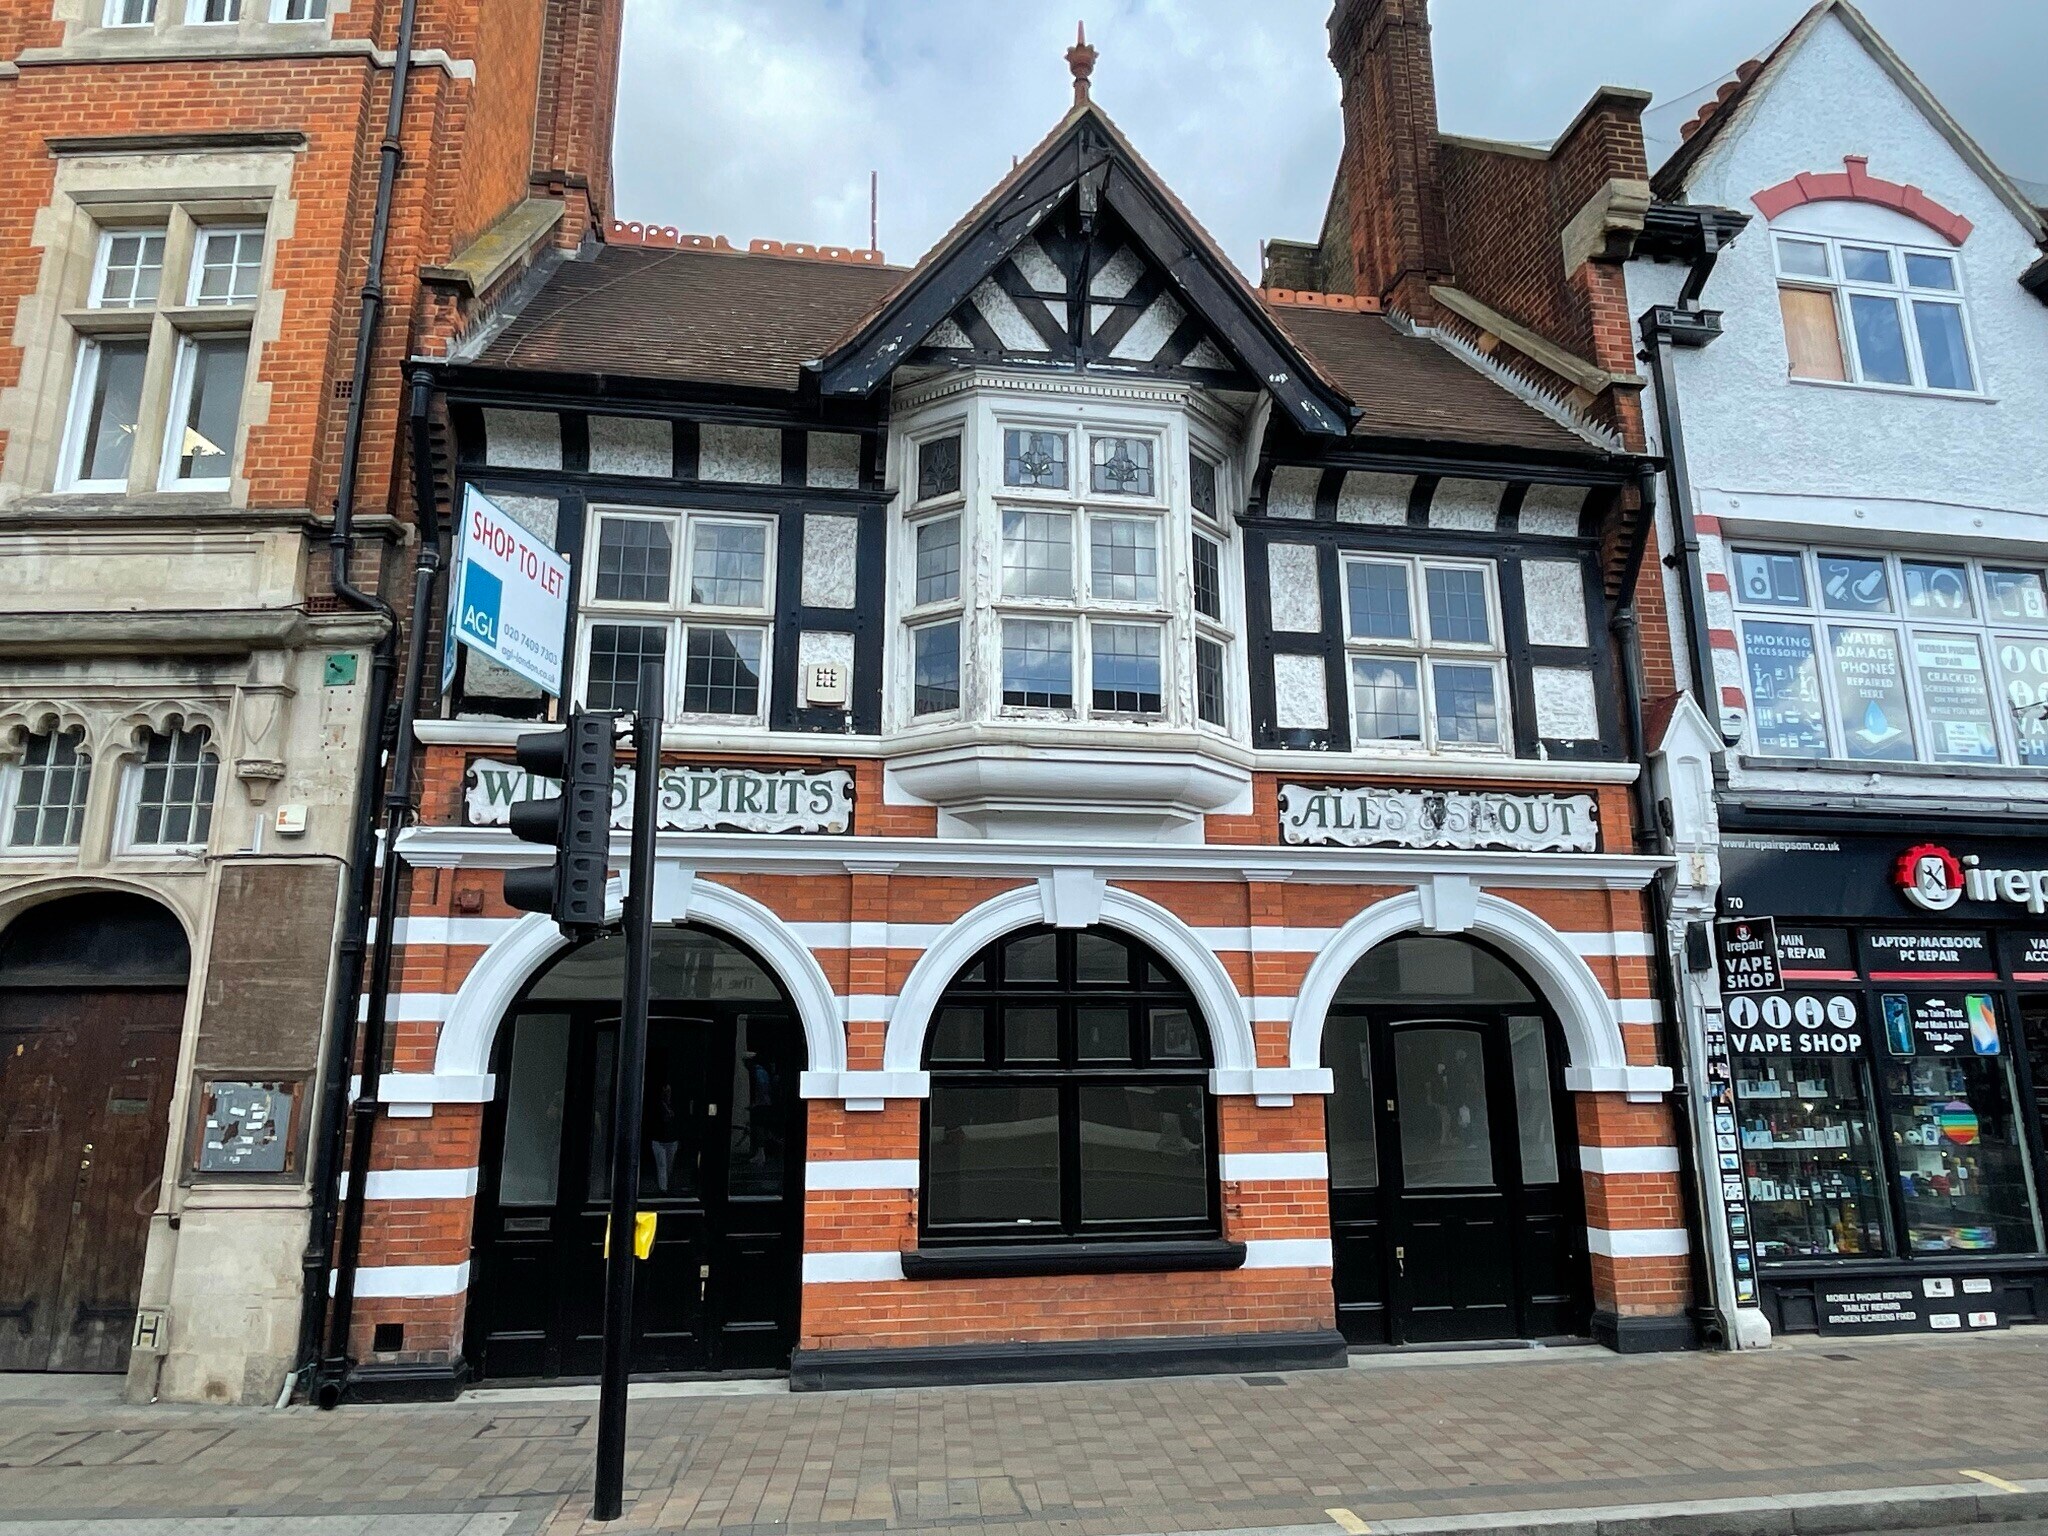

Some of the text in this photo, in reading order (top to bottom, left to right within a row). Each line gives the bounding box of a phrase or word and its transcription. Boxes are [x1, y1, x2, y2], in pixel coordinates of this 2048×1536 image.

[473, 511, 564, 599] SHOP TO LET
[464, 605, 496, 643] AGL
[504, 624, 519, 642] 020
[521, 634, 539, 654] 7409
[1745, 634, 1811, 648] SMOKING
[1840, 632, 1885, 645] WATER
[1747, 647, 1813, 658] ACCESSORIES
[1836, 646, 1895, 660] DAMAGE
[1840, 661, 1896, 675] PHONES
[1847, 676, 1894, 688] REPAIRED
[1927, 671, 1977, 684] CRACKED
[1860, 689, 1885, 699] HERE
[662, 774, 834, 816] SPIRITS
[1291, 795, 1405, 830] ALES
[1722, 840, 1840, 853] www.irepairepsom.co.uk
[1728, 898, 1743, 910] 70
[1727, 938, 1764, 954] irepair
[1781, 934, 1804, 946] MIN
[1787, 947, 1826, 959] REPAIR
[1900, 950, 1960, 962] PC REPAIR
[1725, 956, 1773, 973] VAPE
[1727, 972, 1775, 989] SHOP
[1731, 1034, 1862, 1053] VAPE SHOP
[137, 1314, 160, 1348] H
